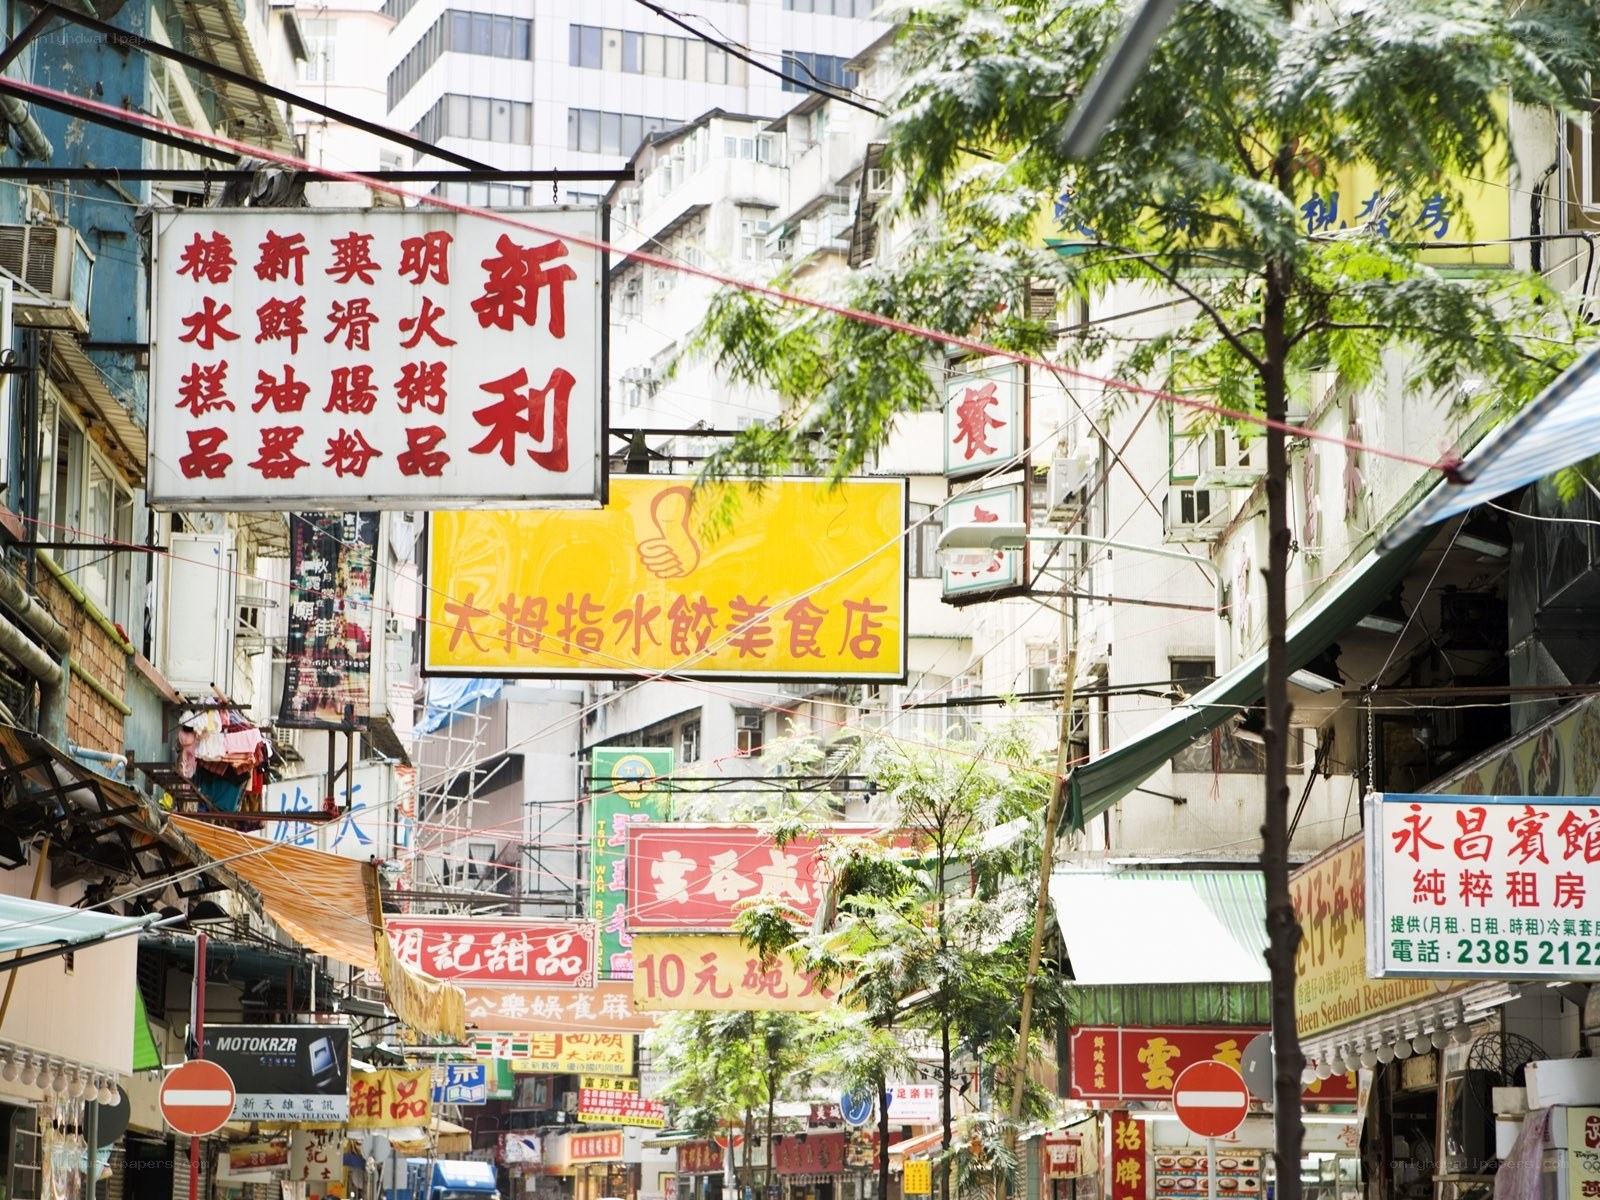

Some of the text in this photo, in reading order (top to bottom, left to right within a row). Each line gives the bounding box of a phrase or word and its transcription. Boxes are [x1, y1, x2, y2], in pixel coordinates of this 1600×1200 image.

[175, 230, 241, 480] 糖水糕品
[247, 230, 310, 479] 新鮮油器
[322, 231, 383, 478] 爽滑腸粉
[393, 230, 458, 477] 明火粥品
[468, 232, 577, 473] 新利
[443, 591, 889, 660] 大拇指水餃美食店
[1412, 869, 1586, 910] 純粹租房
[1457, 939, 1529, 965] 2385
[216, 1037, 298, 1052] MOTOKRZR
[1320, 988, 1362, 1026] Seafood
